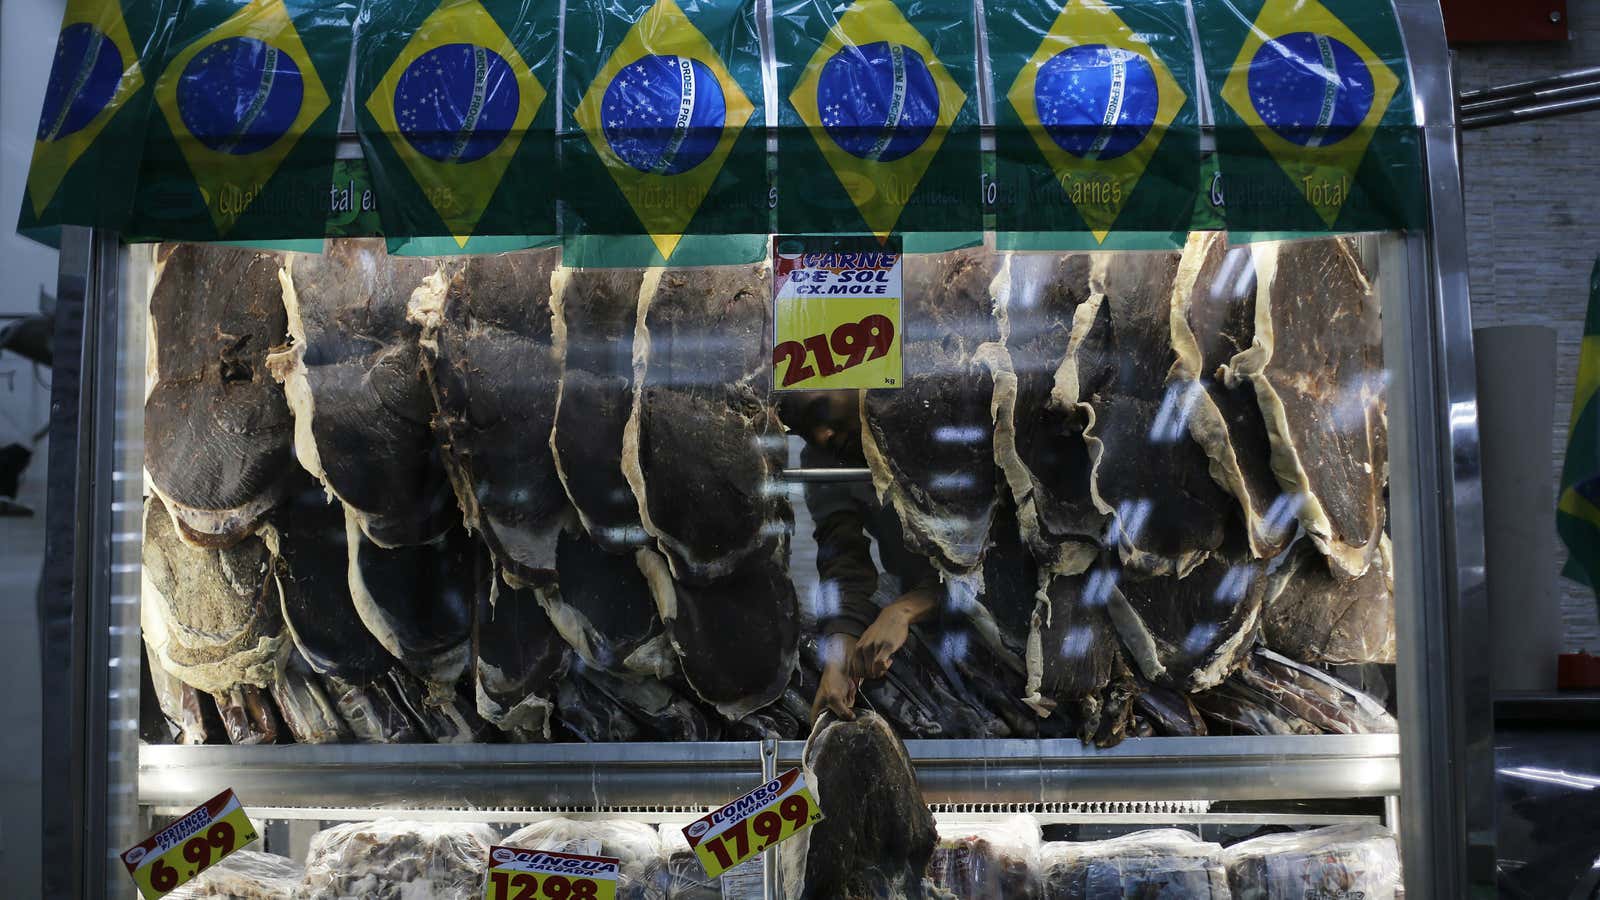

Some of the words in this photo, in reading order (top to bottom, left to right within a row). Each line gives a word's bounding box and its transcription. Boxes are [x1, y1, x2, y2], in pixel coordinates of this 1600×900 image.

[1302, 175, 1347, 206] Total
[802, 251, 897, 270] CARNE
[791, 270, 829, 283] DE
[838, 270, 889, 283] SOL
[796, 285, 888, 295] CX.MOLE
[884, 377, 896, 385] kg
[712, 780, 780, 824] LOMBO
[730, 793, 777, 824] SALGADO
[810, 812, 821, 821] kg
[155, 808, 208, 847] PERTENCES
[705, 794, 809, 870] 17.99
[150, 821, 236, 893] 6.99
[516, 852, 615, 873] LÍNGUA
[526, 864, 594, 876] SALGADA
